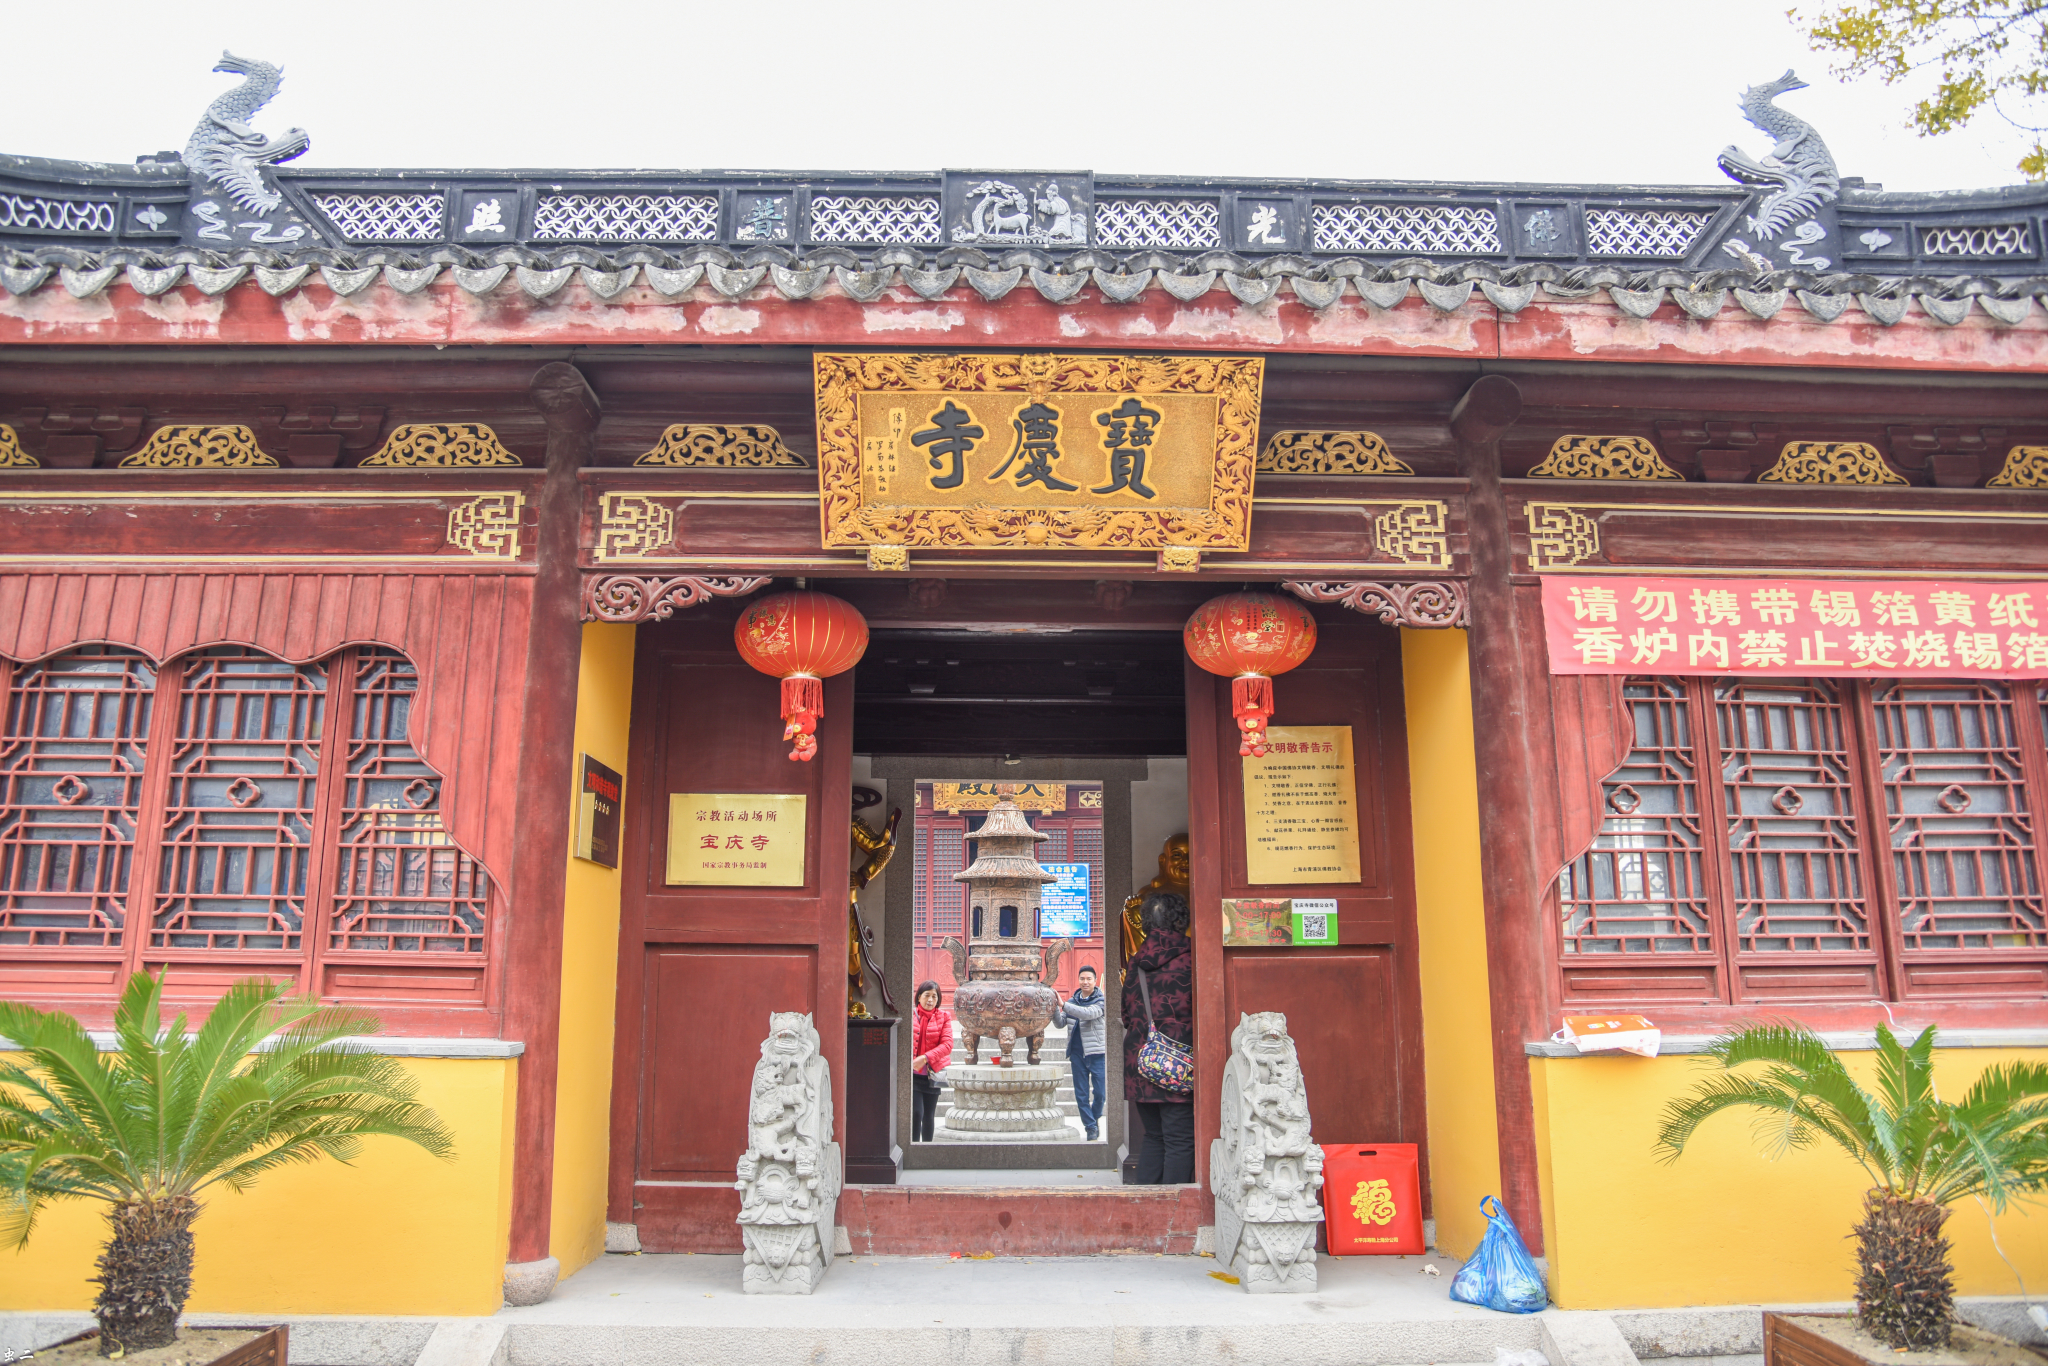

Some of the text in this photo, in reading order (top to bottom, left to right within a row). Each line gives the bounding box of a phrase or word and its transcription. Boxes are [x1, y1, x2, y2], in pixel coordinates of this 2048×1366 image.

[743, 197, 783, 237] 普
[1246, 202, 1287, 245] 光
[1566, 586, 2048, 628] 请勿携带锡箔黄纸
[1263, 741, 1334, 754] 文明敬香告示
[695, 810, 778, 822] 宗教活动场所
[699, 834, 771, 851] 宝庆寺
[702, 861, 768, 870] 国家宗教事务局监制
[1350, 1179, 1396, 1226] 福
[1353, 1236, 1399, 1244] 太平洋寿险上海分公司
